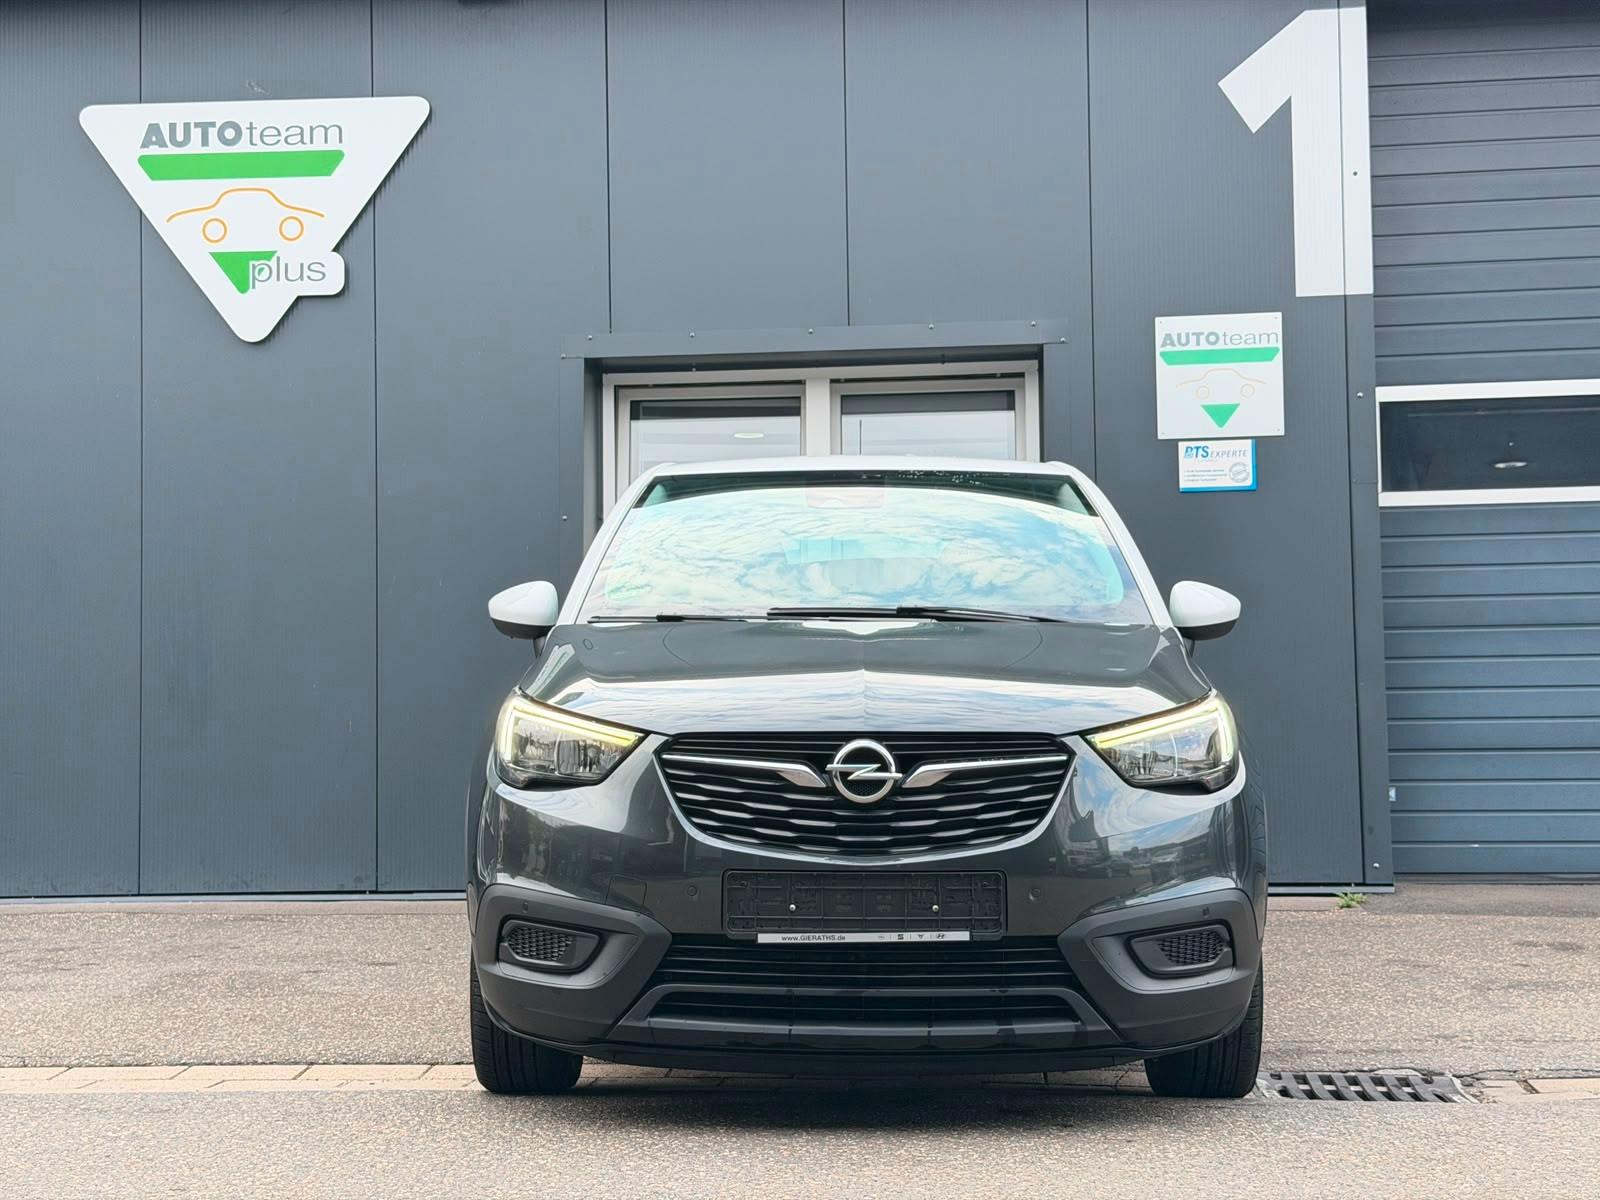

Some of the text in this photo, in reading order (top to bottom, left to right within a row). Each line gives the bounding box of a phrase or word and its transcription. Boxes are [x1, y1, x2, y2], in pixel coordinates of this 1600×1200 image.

[1218, 7, 1374, 297] 1
[251, 256, 327, 290] plus
[1210, 447, 1249, 458] EXPERTE
